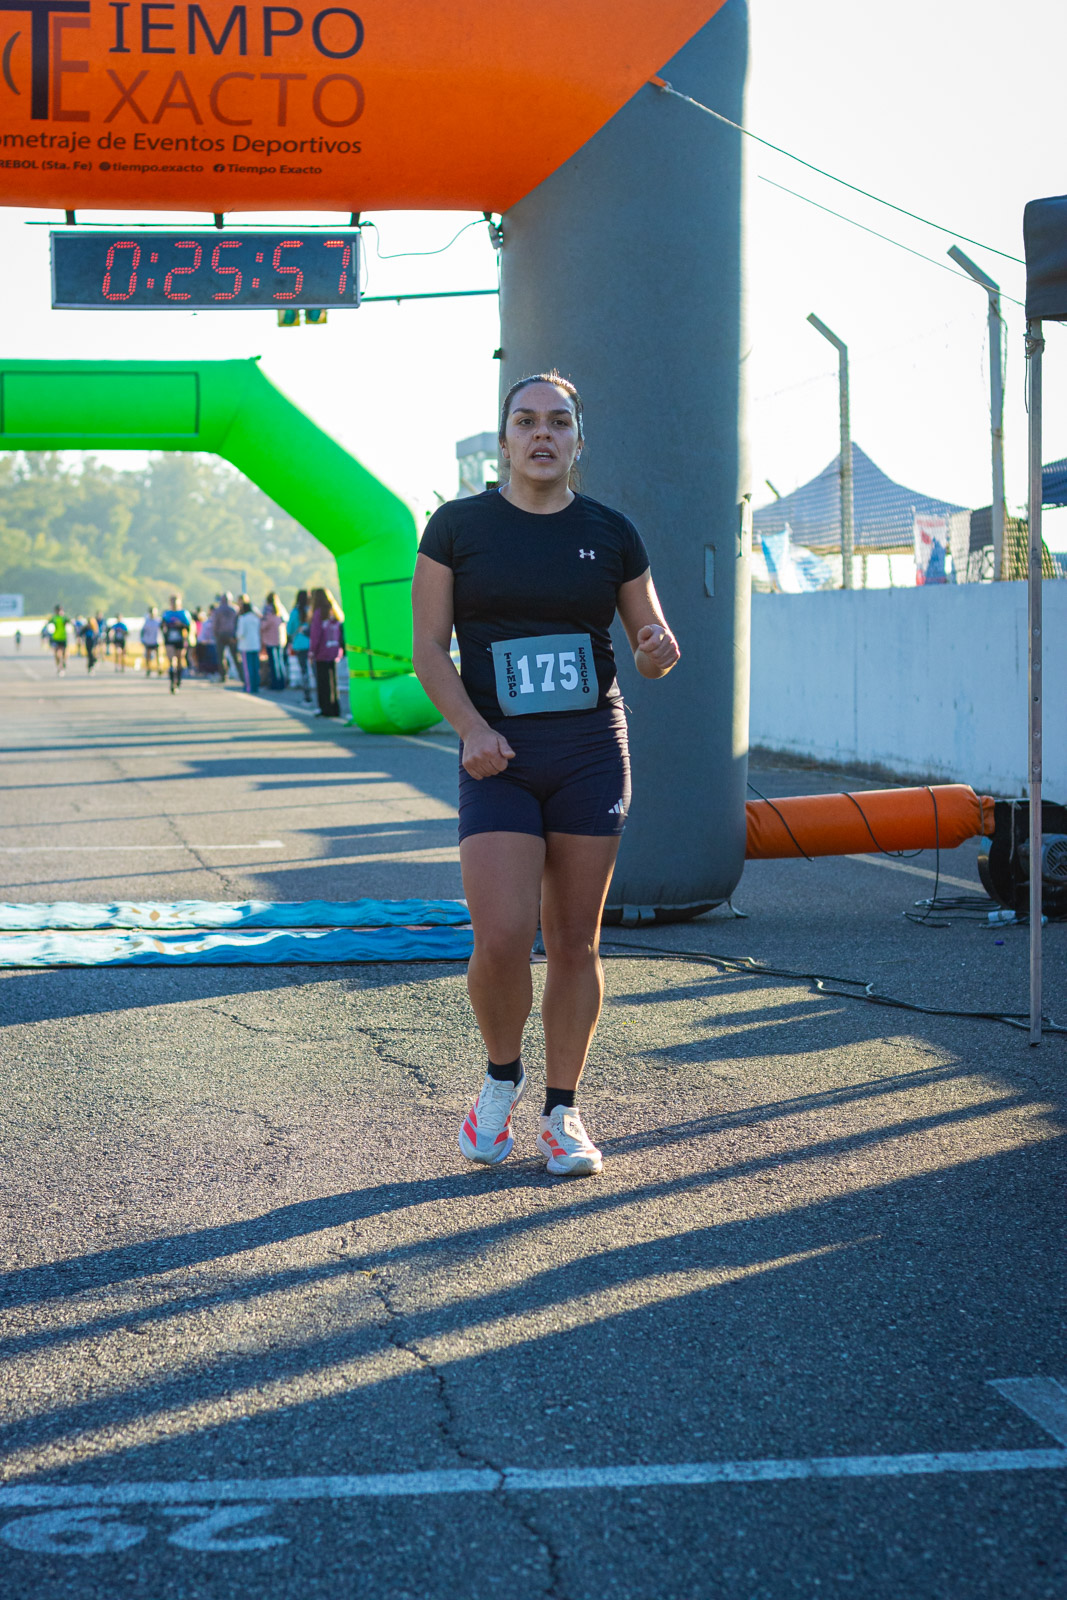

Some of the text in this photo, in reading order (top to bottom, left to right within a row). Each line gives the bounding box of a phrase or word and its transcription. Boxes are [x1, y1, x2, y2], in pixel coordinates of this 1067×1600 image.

[0, 131, 362, 156] metraje de Eventos Deportivos
[73, 161, 92, 171] Fe)
[112, 162, 204, 173] tiempo.exacto
[227, 163, 322, 175] Tiempo Exacto
[503, 651, 518, 698] TIEMPO
[516, 651, 579, 694] 175
[577, 646, 590, 694] EXACTO
